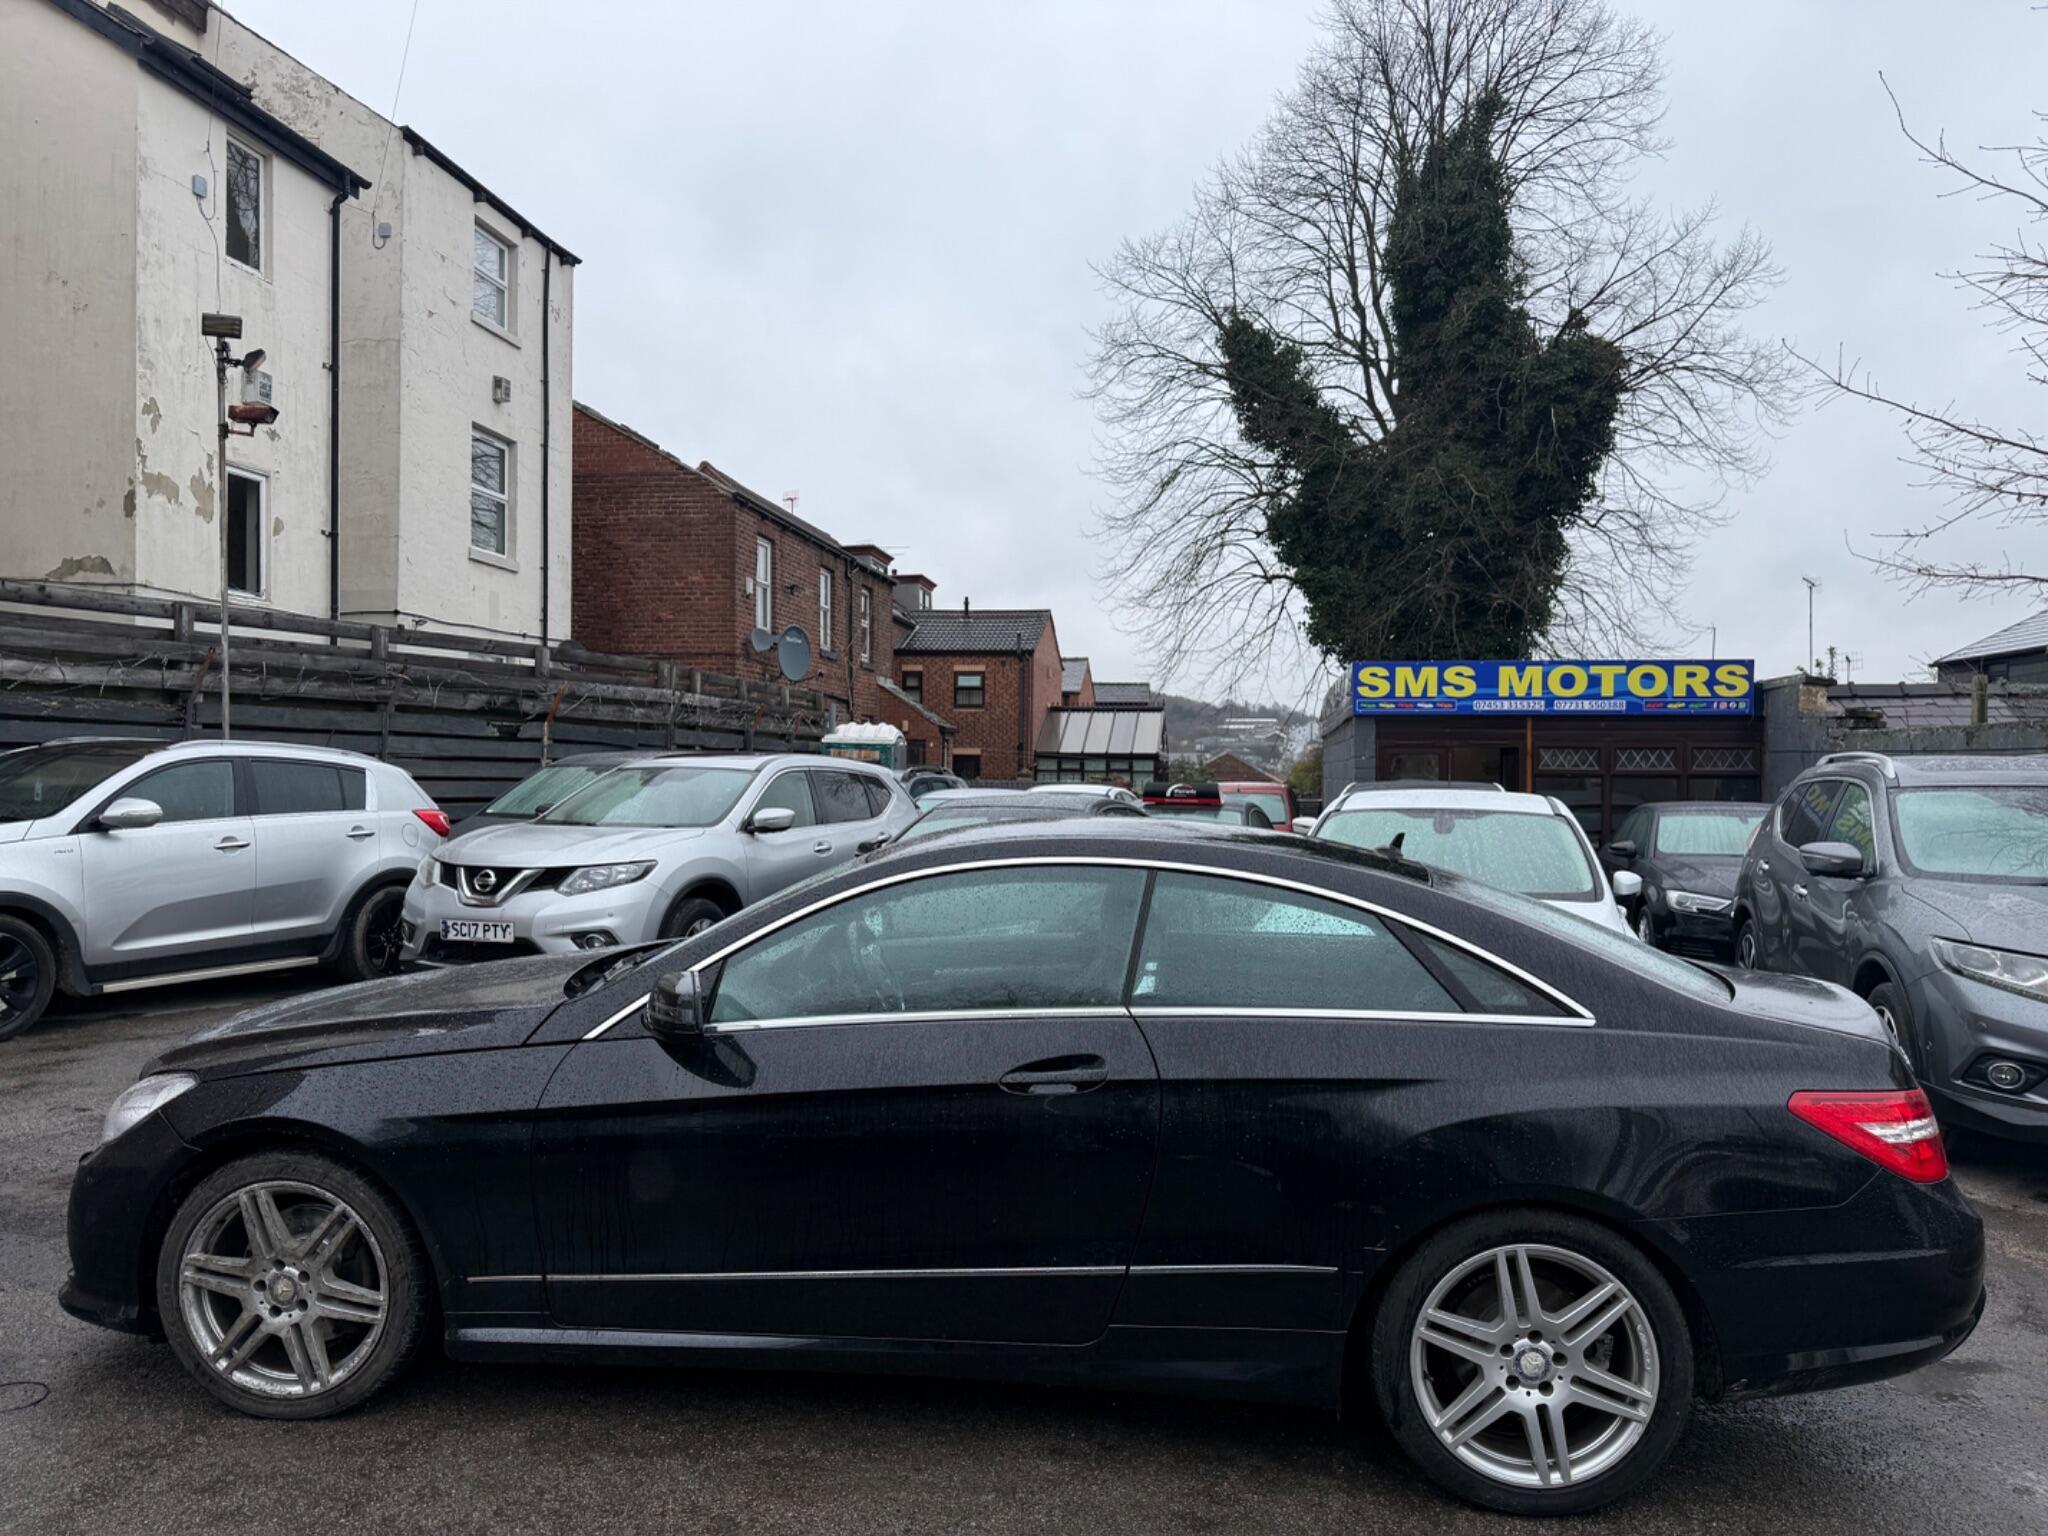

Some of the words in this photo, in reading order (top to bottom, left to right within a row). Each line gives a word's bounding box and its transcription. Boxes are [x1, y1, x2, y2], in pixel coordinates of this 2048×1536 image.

[1357, 665, 1477, 697] SMS
[1499, 665, 1751, 698] MOTORS
[451, 922, 479, 938] SC17
[483, 923, 510, 939] PTY
